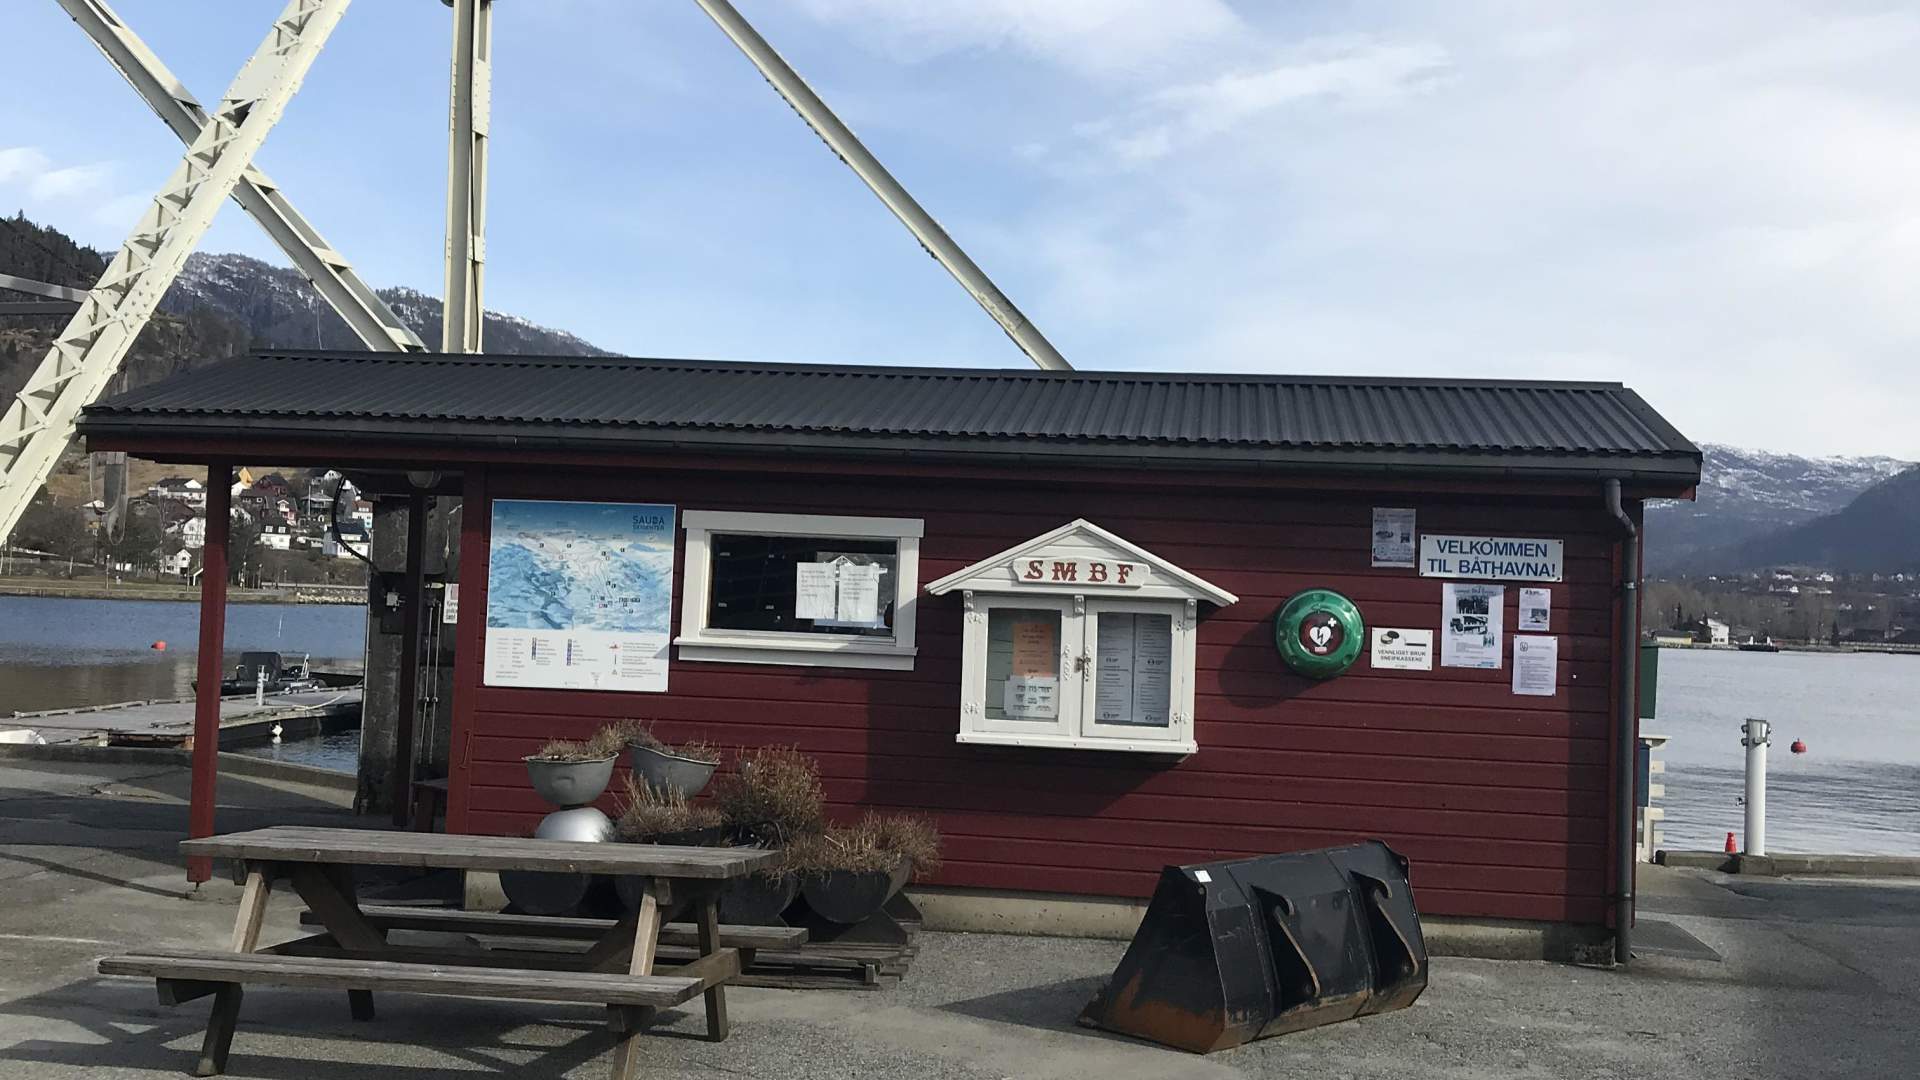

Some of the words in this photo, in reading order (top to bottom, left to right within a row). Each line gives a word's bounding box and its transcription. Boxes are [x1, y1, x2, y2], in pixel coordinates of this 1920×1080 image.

[632, 515, 665, 525] SAUDA
[1437, 539, 1548, 558] VELKOMMEN
[1024, 560, 1134, 584] SMBF
[1427, 558, 1453, 573] TIL
[1459, 556, 1556, 577] BÅTHAVNA!
